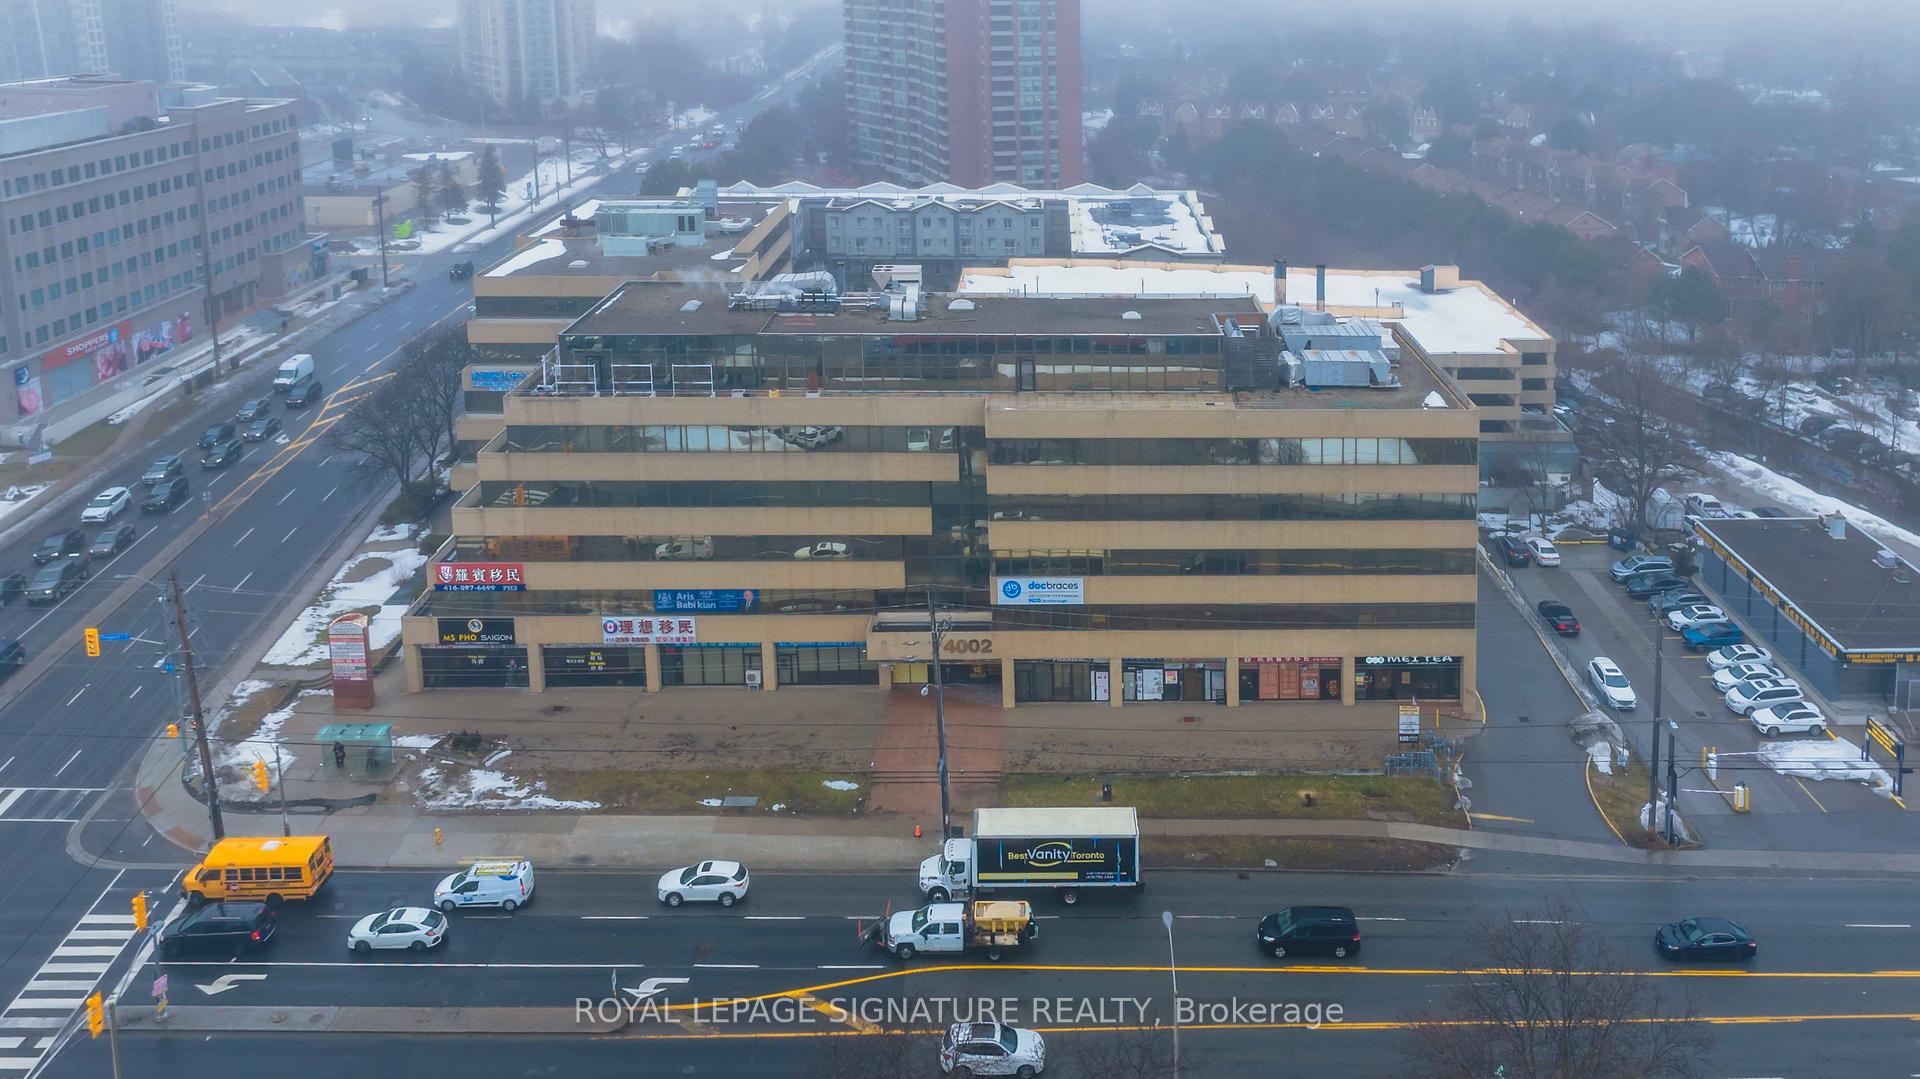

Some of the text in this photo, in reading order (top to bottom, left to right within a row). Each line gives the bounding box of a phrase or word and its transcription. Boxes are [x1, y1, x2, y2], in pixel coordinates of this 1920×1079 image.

[66, 332, 109, 356] SHOPPERS
[1028, 581, 1079, 590] docbraces
[676, 592, 695, 600] Aris
[676, 600, 717, 609] Babikian
[618, 619, 693, 634] 理想移民
[943, 639, 993, 654] 4002
